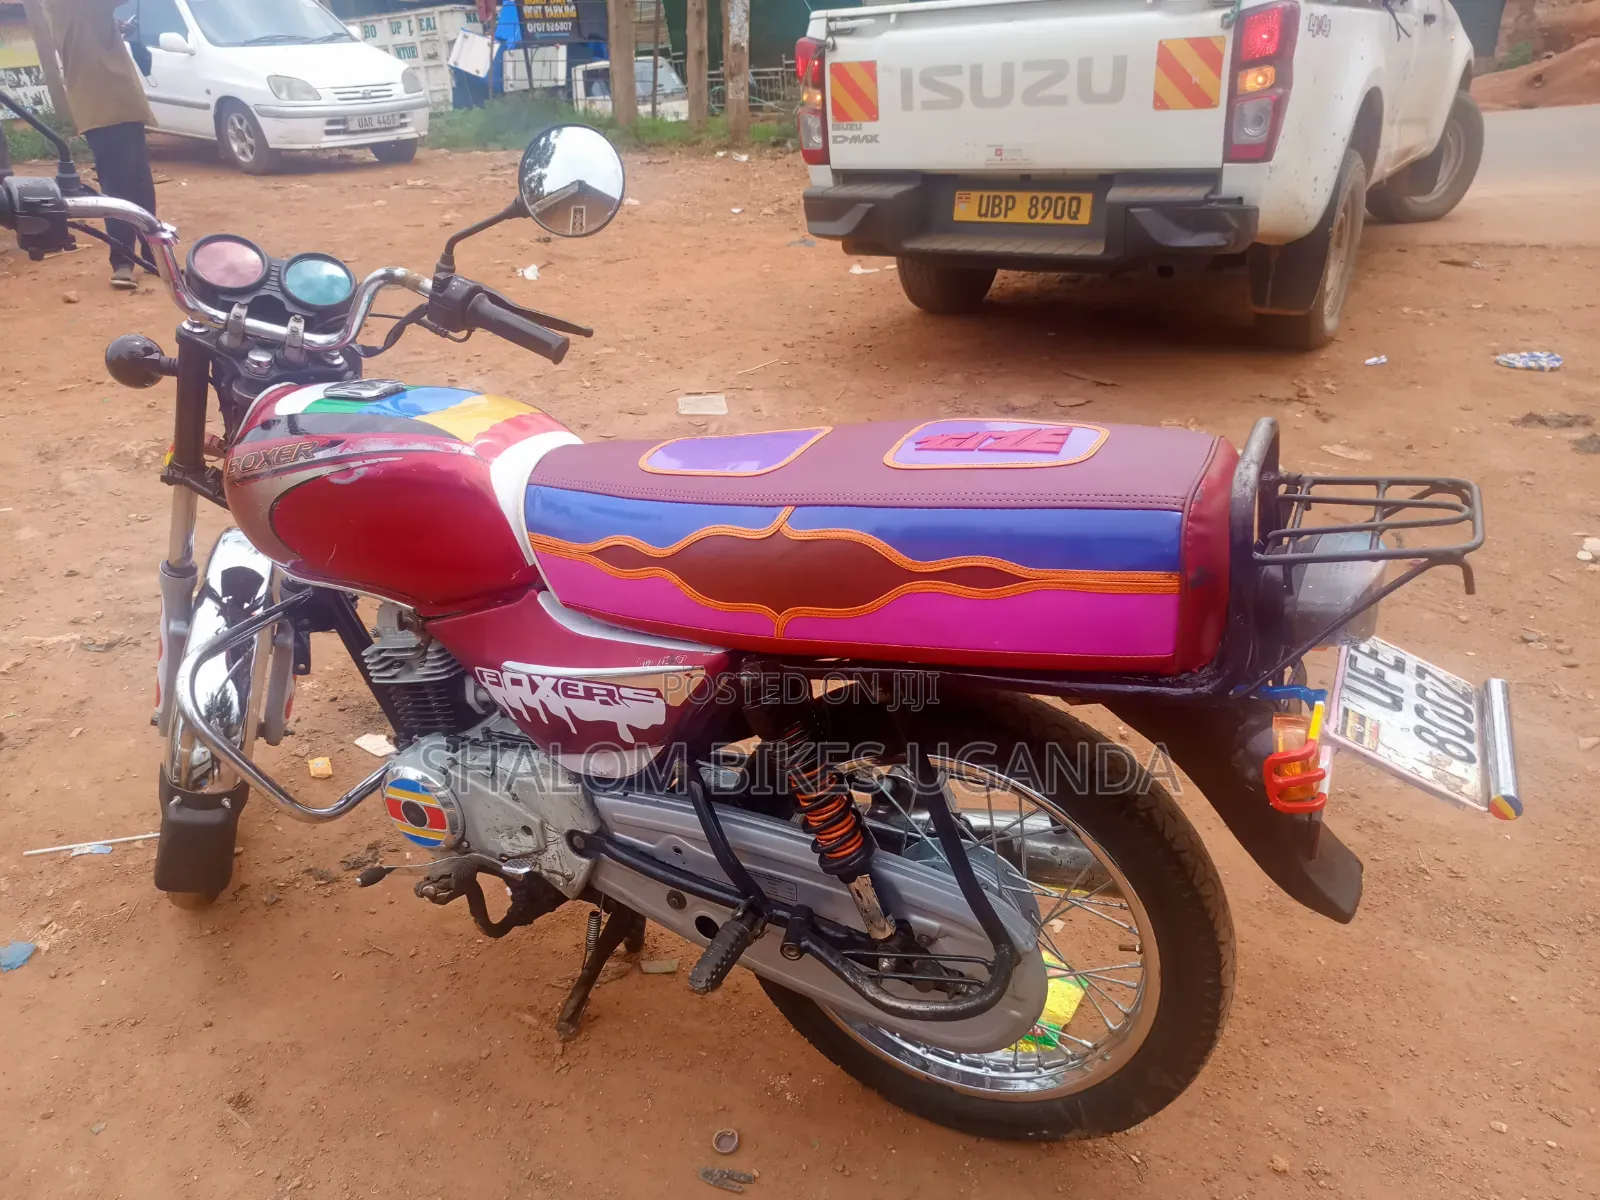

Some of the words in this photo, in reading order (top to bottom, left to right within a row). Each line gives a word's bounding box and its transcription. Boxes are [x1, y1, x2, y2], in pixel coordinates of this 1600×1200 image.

[544, 5, 577, 18] PARKING
[900, 55, 1128, 111] ISUZU
[977, 194, 1017, 219] UBP
[1027, 195, 1082, 221] 890Q
[226, 440, 320, 477] BOXER
[474, 665, 666, 727] BOXERS
